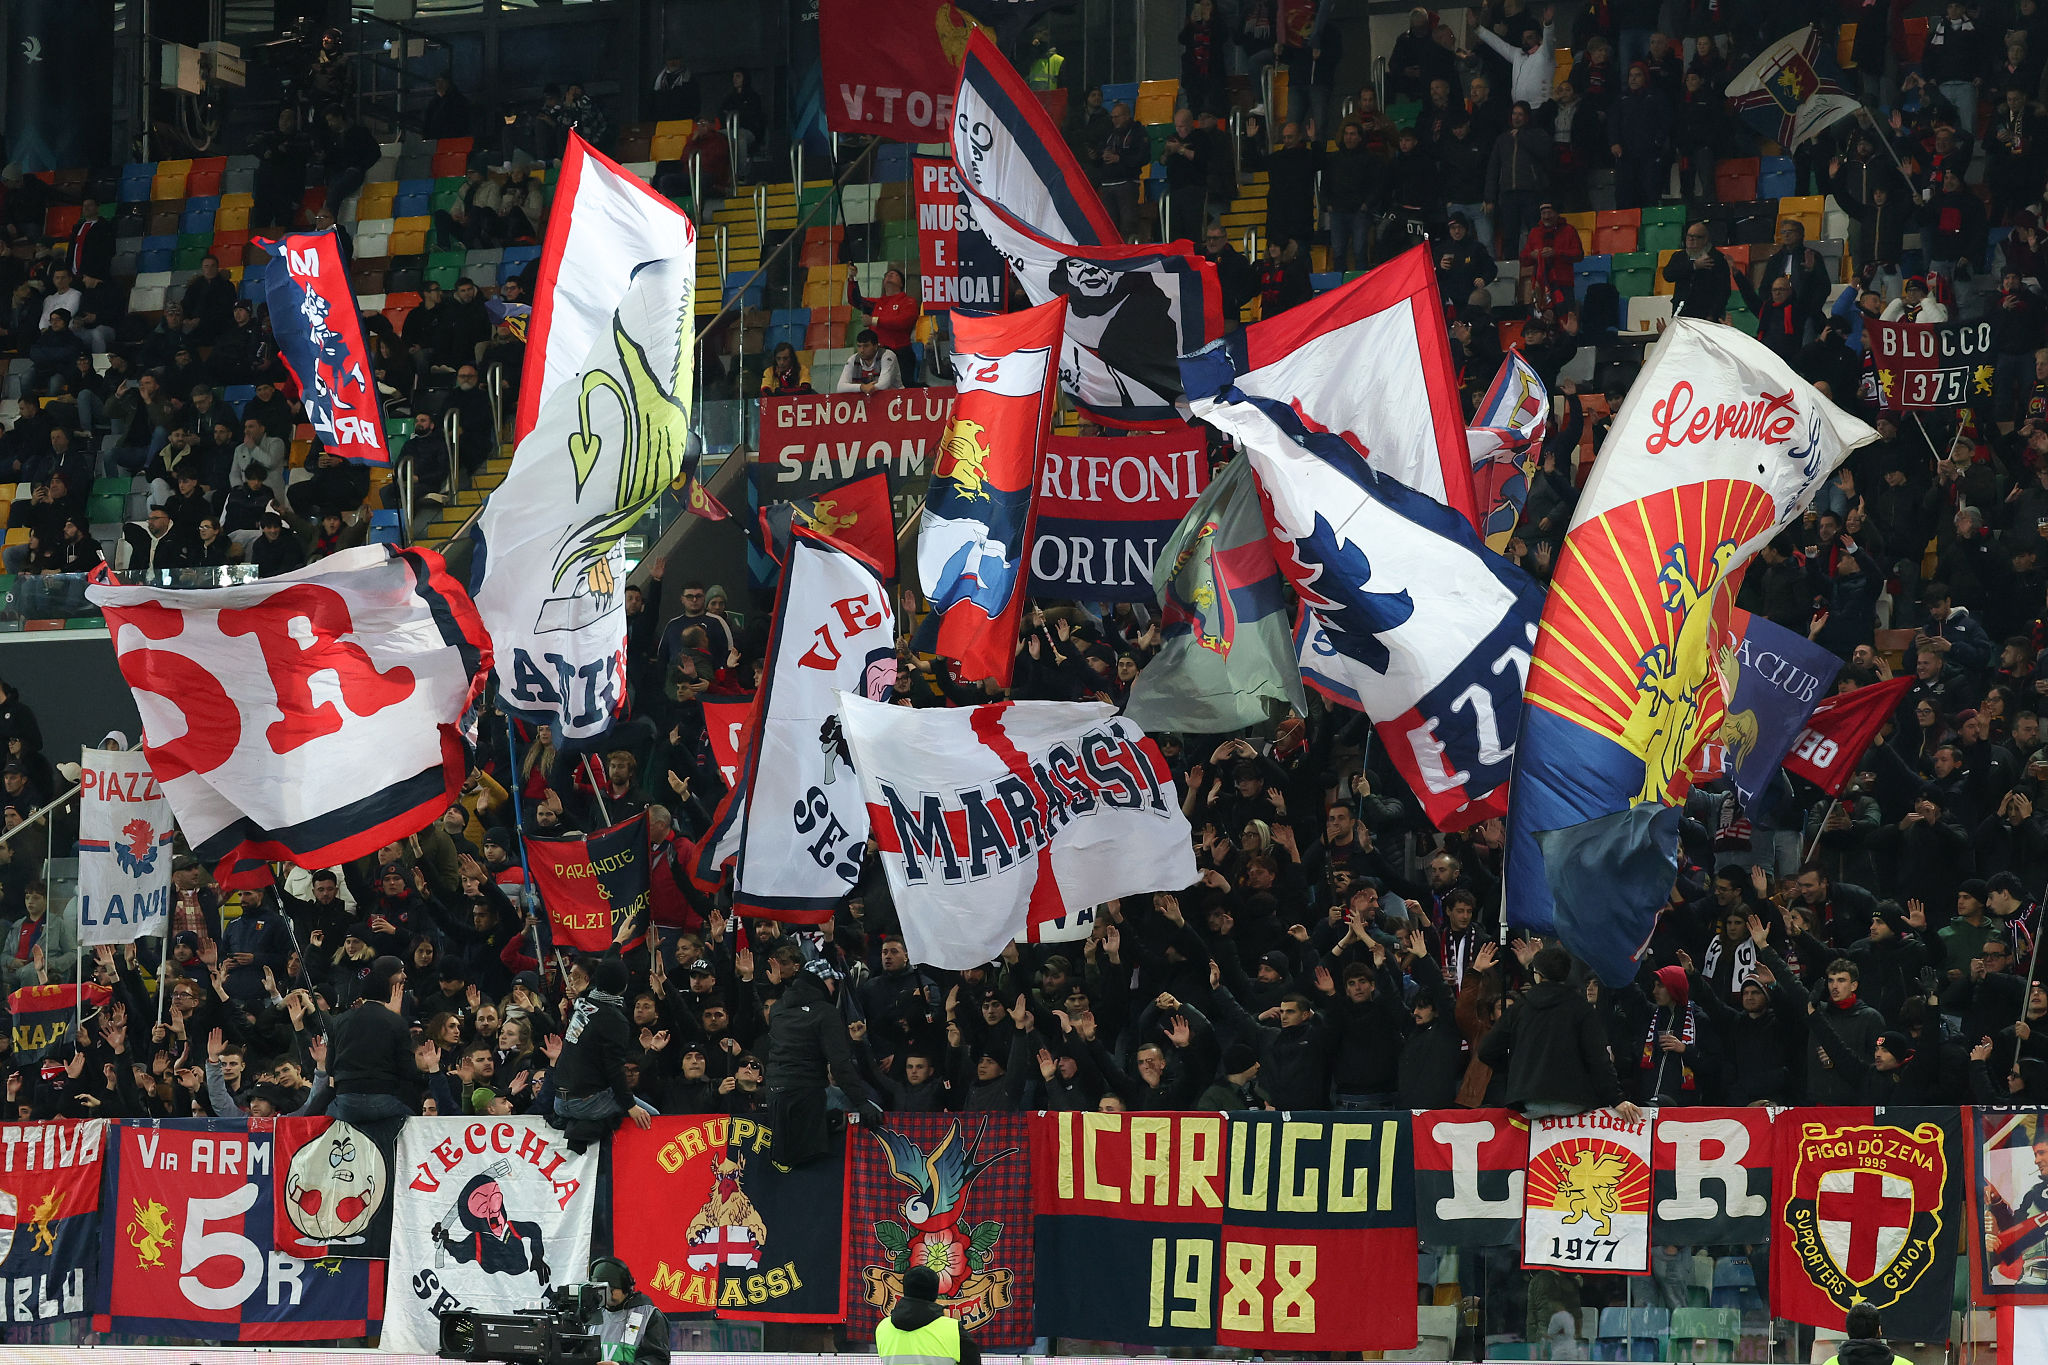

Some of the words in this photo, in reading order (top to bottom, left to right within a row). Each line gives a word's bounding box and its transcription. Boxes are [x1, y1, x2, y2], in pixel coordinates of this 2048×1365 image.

[921, 275, 1000, 303] GENOA!
[1882, 322, 1991, 358] BLOCCO
[1912, 371, 1962, 402] 375
[777, 400, 868, 428] GENOA
[1646, 381, 1800, 455] Levante
[80, 768, 166, 802] PIAZZ
[875, 717, 1172, 887] MARASSI
[555, 849, 635, 879] PARANOIE
[597, 884, 613, 899] &
[191, 1138, 271, 1176] ARM
[408, 1122, 581, 1212] VECCHIA
[1806, 1140, 1854, 1162] FIGGI
[1857, 1133, 1934, 1172] DÖZENA
[1858, 1156, 1888, 1169] 1995
[1551, 1236, 1620, 1263] 1977
[1795, 1208, 1848, 1296] SUPPORTERS
[1882, 1238, 1928, 1290] GENOA
[1149, 1237, 1317, 1334] 1988
